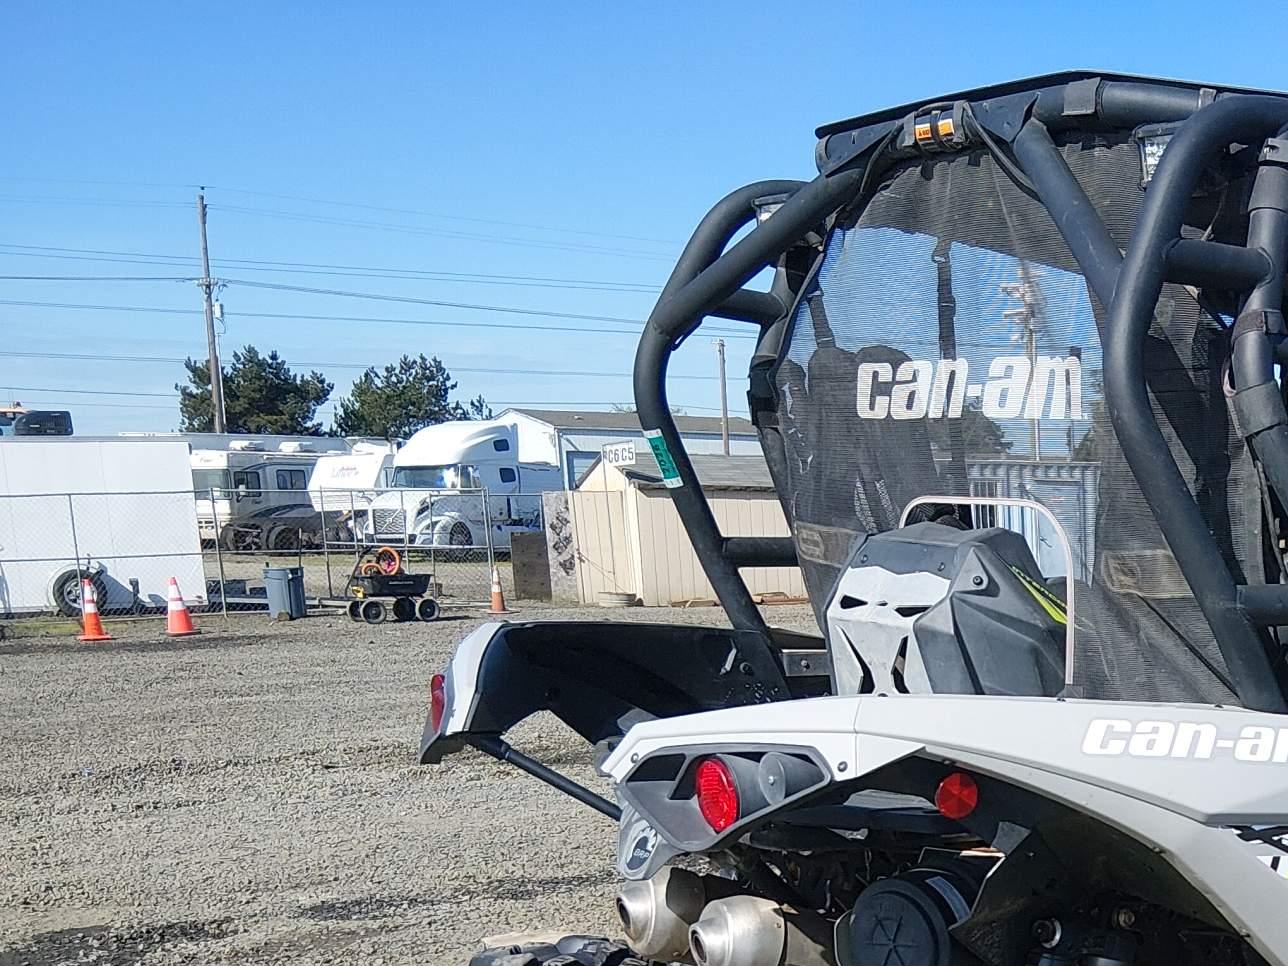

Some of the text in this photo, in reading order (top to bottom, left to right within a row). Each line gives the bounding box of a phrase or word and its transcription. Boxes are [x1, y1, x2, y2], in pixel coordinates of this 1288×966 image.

[856, 356, 1082, 420] can-am
[608, 449, 620, 464] C6
[621, 447, 634, 461] C5
[633, 848, 650, 859] BRP
